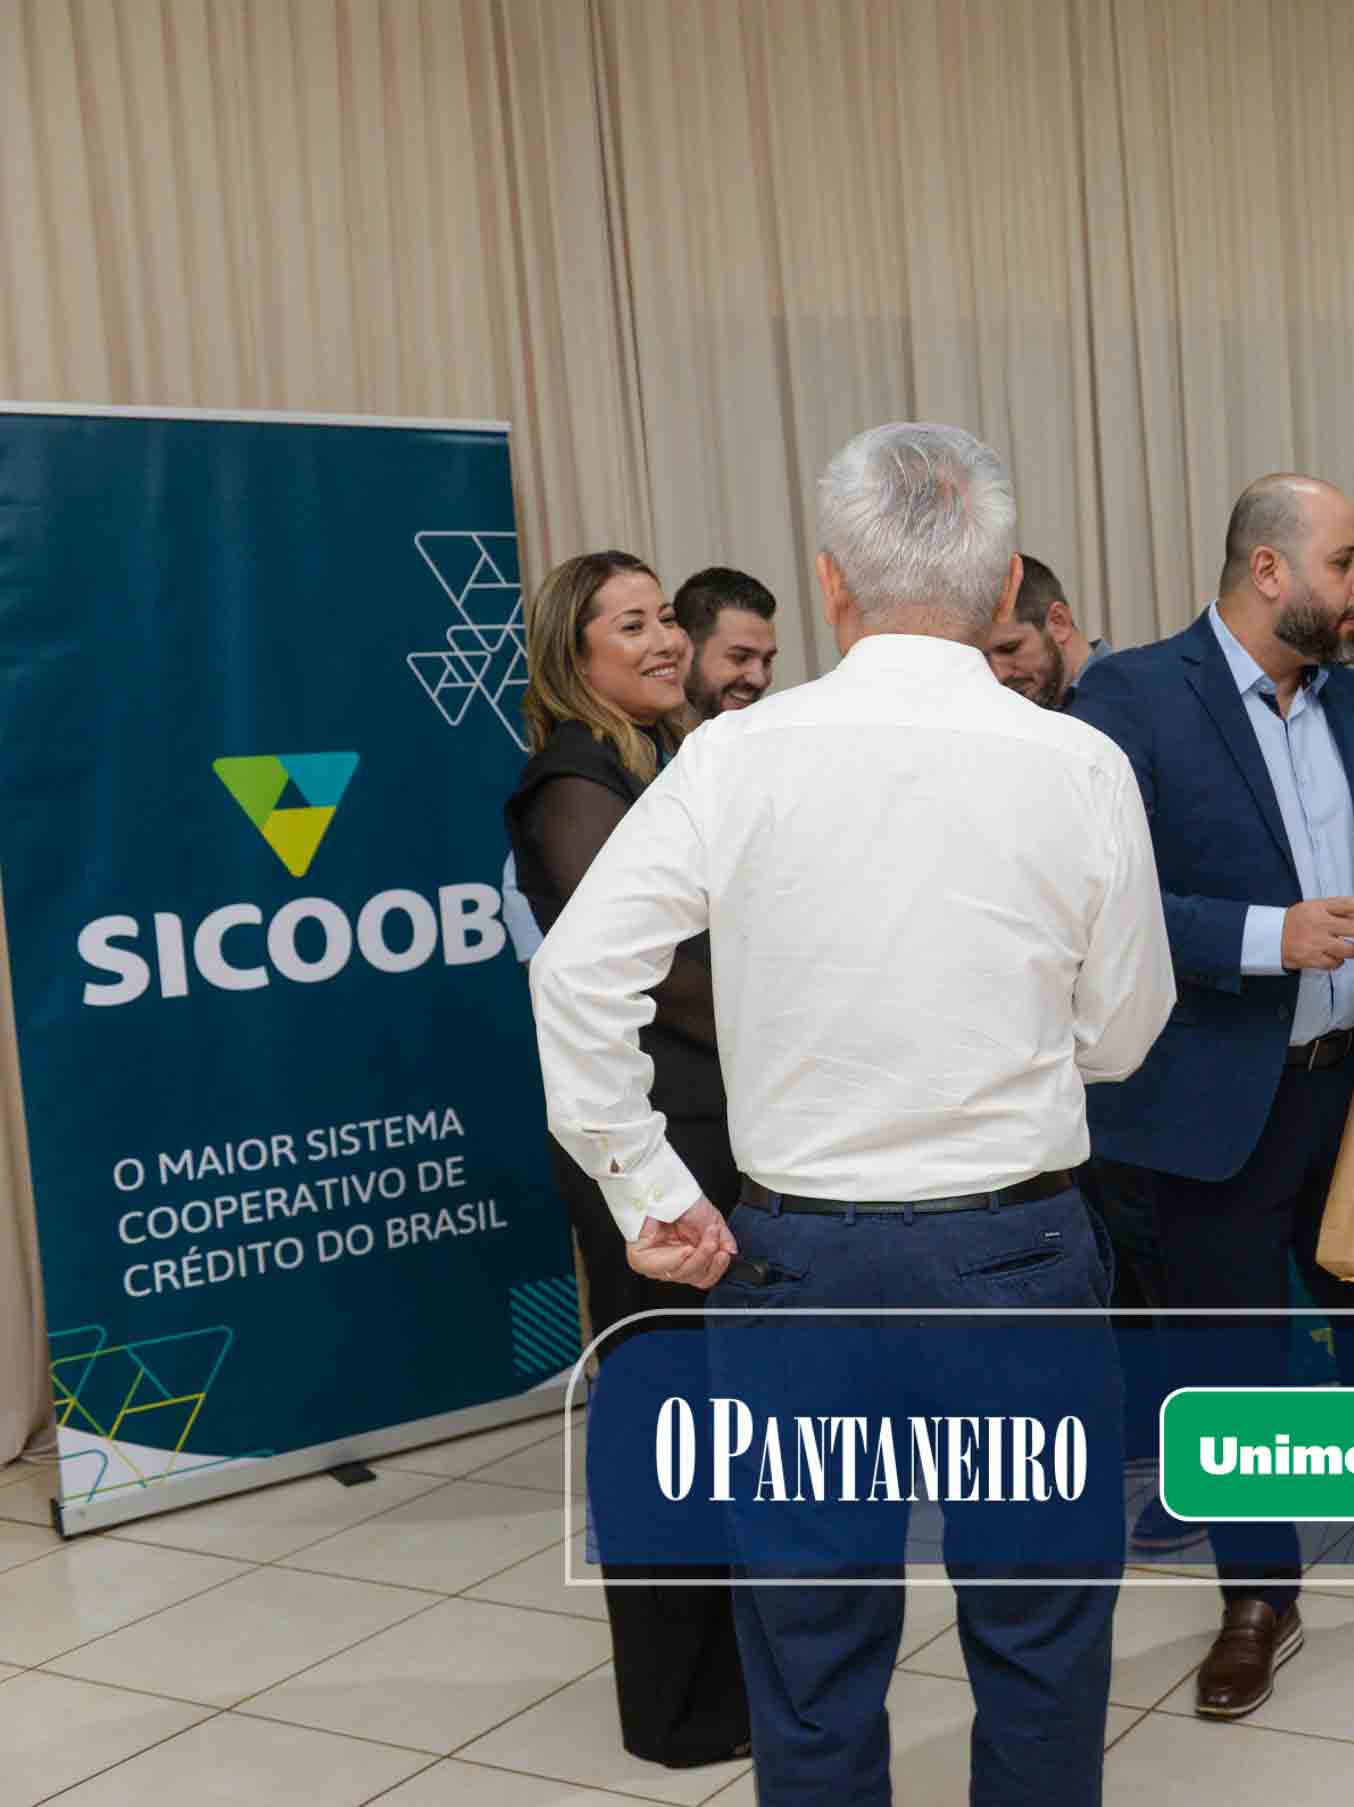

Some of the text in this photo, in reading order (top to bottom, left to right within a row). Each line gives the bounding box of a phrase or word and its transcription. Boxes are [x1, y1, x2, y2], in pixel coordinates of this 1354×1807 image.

[77, 882, 506, 1006] SICOOB
[113, 1108, 465, 1191] O MAIOR SISTEMA
[118, 1156, 465, 1244] COOPERATIVO DE
[123, 1199, 508, 1297] CRÉDITO DO BRASIL
